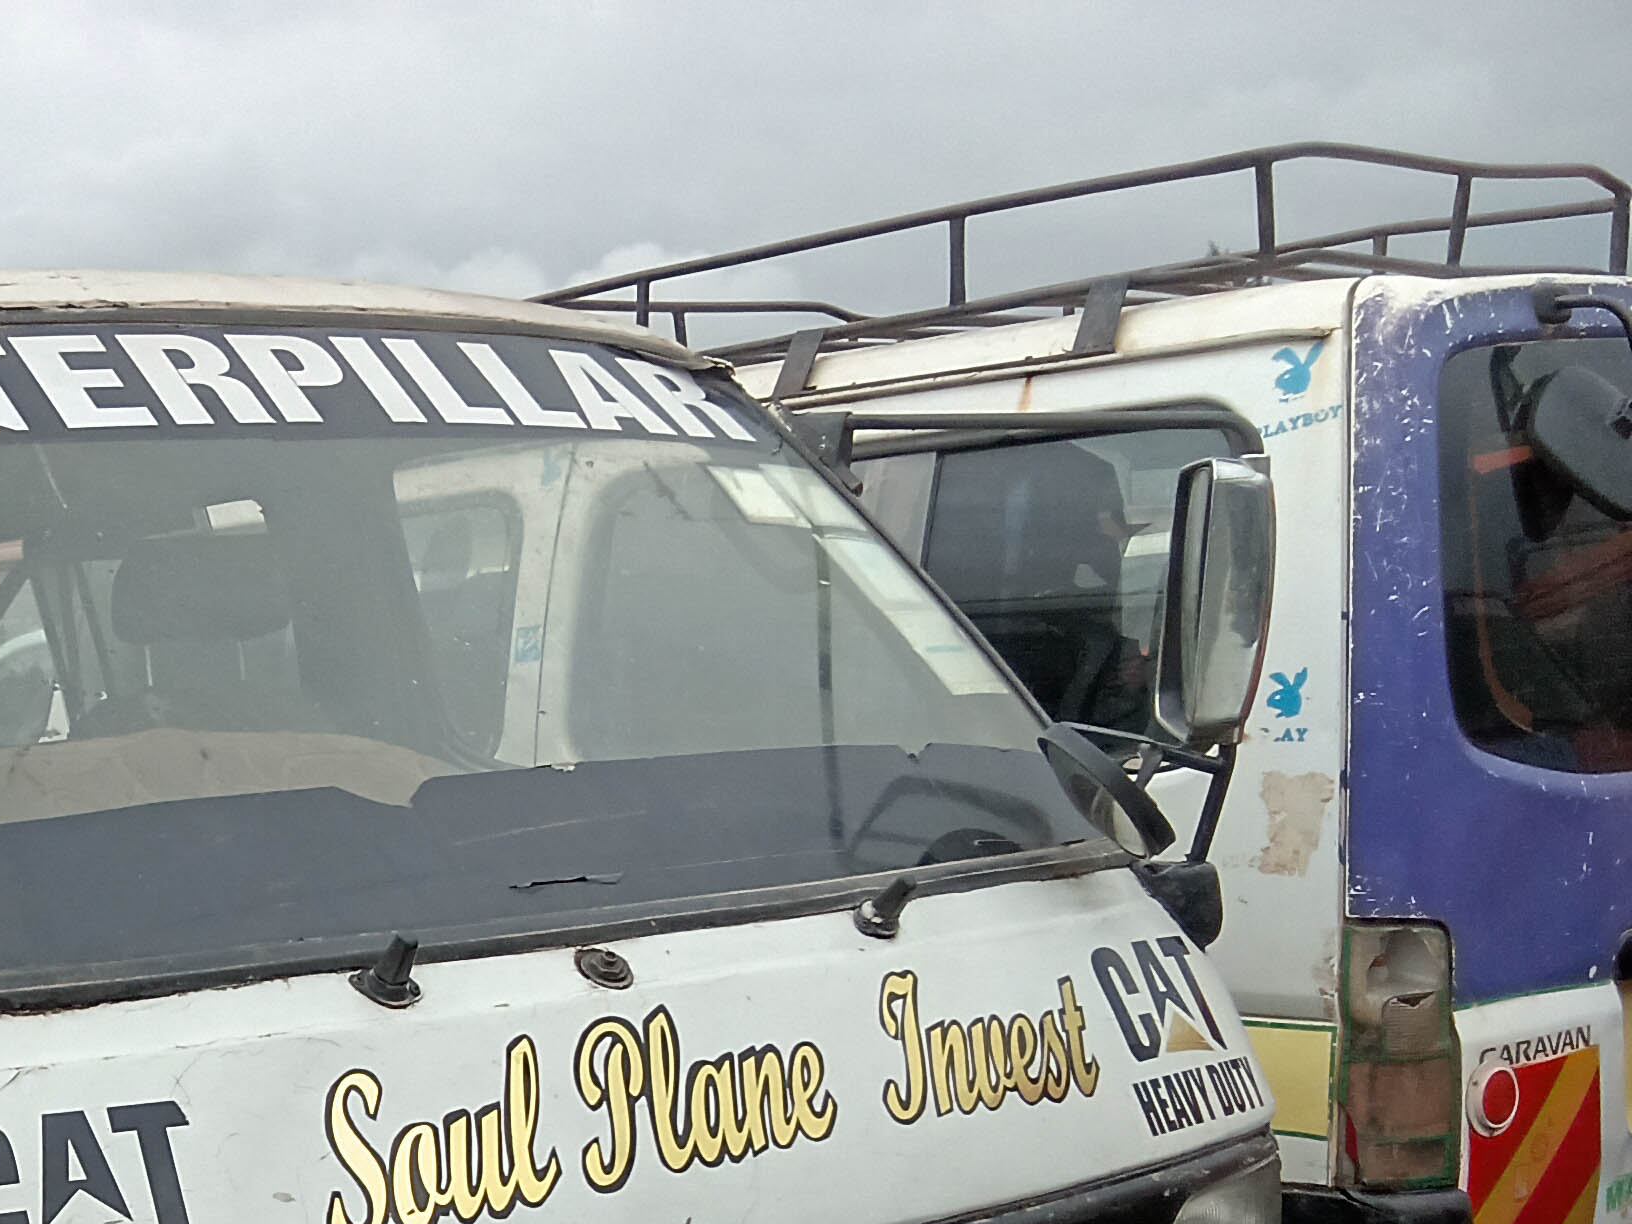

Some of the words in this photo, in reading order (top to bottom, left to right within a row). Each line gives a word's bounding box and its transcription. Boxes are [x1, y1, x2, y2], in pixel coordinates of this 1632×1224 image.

[1091, 935, 1228, 1062] CAT
[574, 1004, 837, 1192] Plane
[879, 970, 1101, 1125] Invest
[1132, 1066, 1216, 1137] HEAVY
[1205, 1056, 1265, 1117] DUTY
